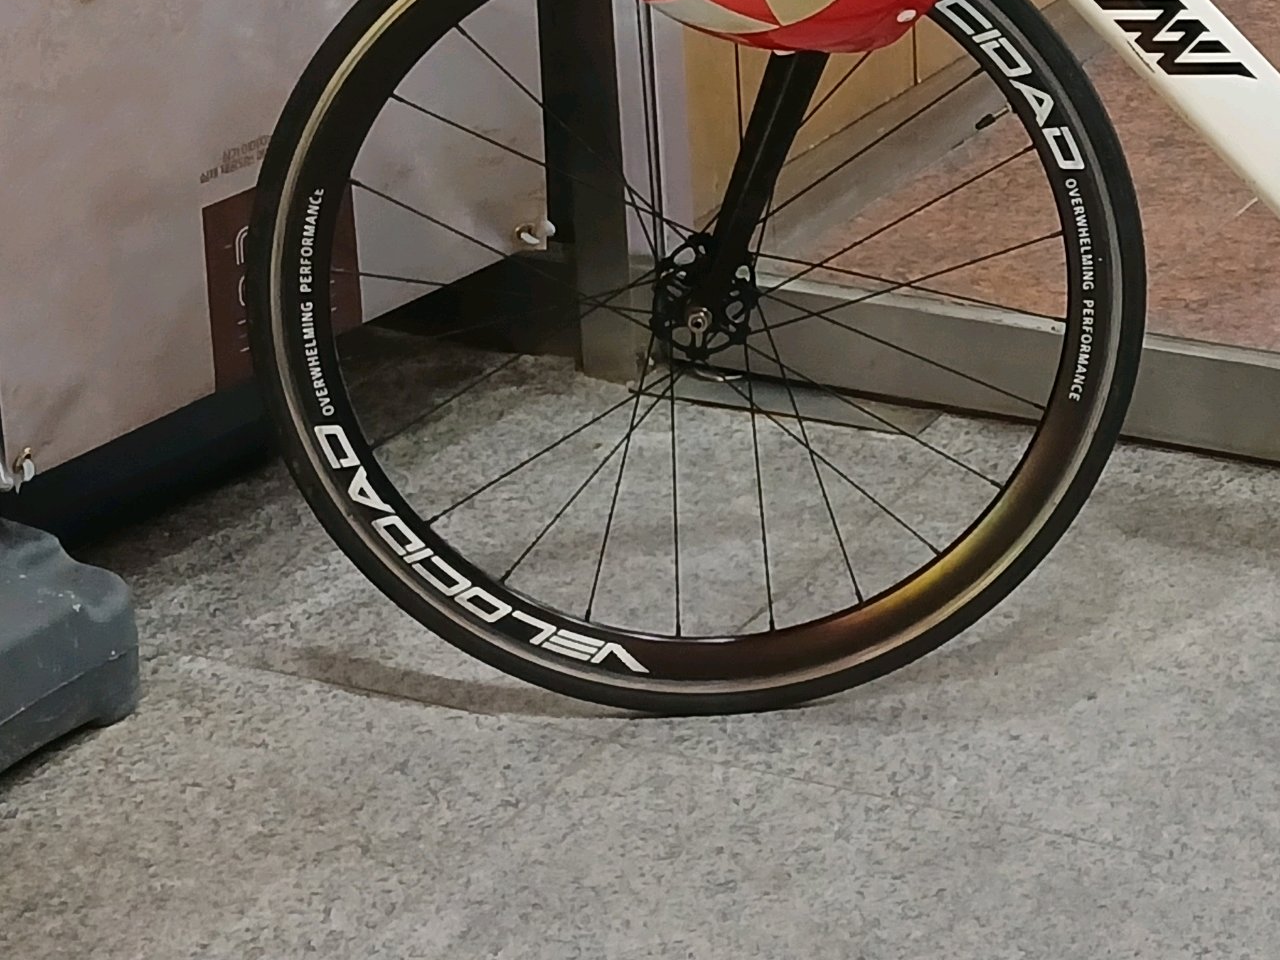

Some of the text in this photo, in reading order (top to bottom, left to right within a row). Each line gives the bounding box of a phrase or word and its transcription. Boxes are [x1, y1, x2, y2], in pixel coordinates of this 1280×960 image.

[299, 187, 335, 417] OVERWHELMING PERFORMANCE
[1064, 178, 1095, 402] OVERWHELMING PERFORMANCE
[314, 424, 650, 673] VELOCIDAD
